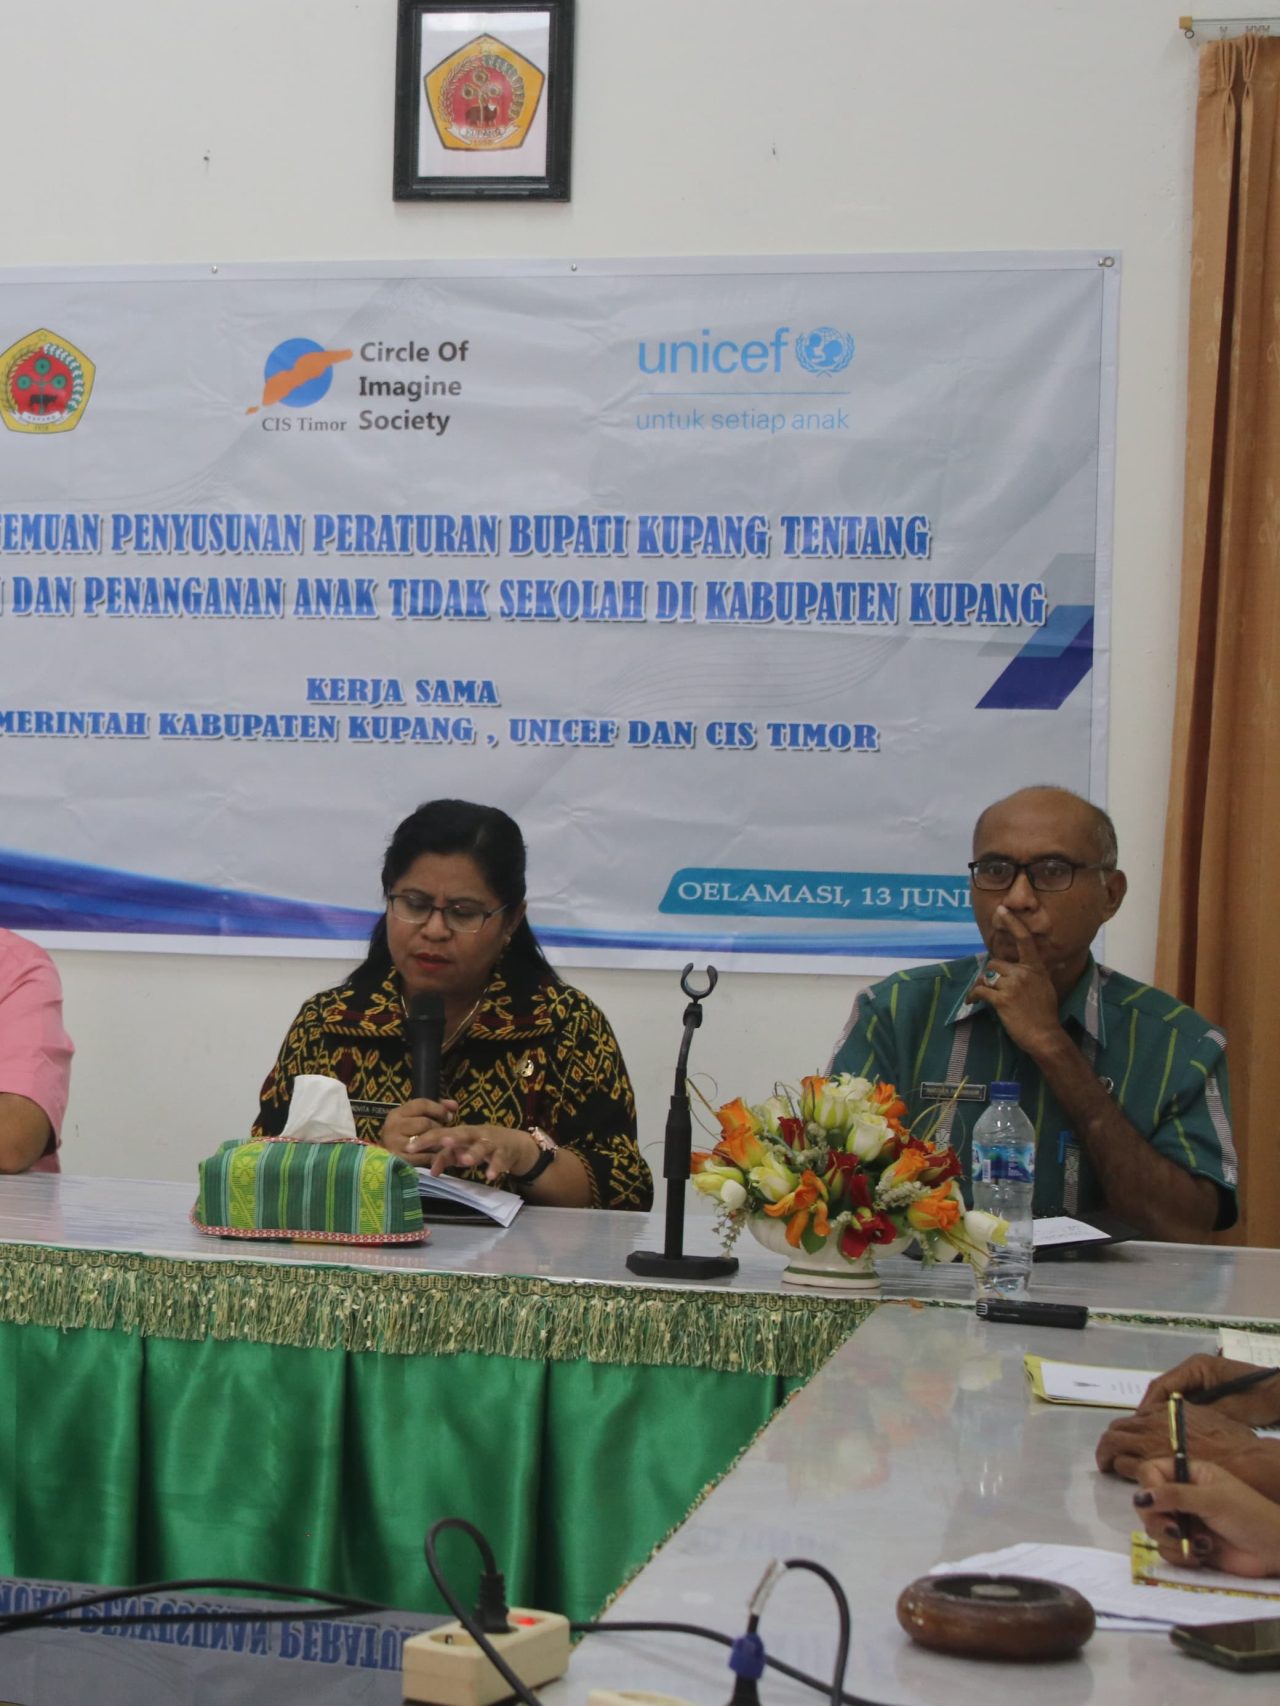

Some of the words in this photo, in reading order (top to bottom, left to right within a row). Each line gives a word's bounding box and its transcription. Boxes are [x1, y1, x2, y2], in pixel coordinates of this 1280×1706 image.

[359, 341, 430, 362] Circle
[438, 340, 470, 362] Of
[637, 326, 790, 375] unicef
[359, 375, 462, 402] Imagine
[261, 417, 293, 432] CIS
[297, 417, 347, 432] Timor
[358, 409, 451, 437] Society
[635, 409, 705, 433] untuk
[710, 408, 788, 434] setiap
[790, 409, 850, 432] anak
[110, 511, 304, 555] PENYUSUNAN
[312, 512, 499, 557] PERATURAN
[509, 513, 628, 557] BUPATI
[637, 514, 770, 558] KUPANG
[779, 514, 931, 559] TENTANG
[11, 575, 75, 617] DAN
[83, 575, 284, 618] PENANGANAN
[293, 576, 379, 619] ANAK
[388, 577, 489, 621] TIDAK
[498, 578, 647, 622] SEKOLAH
[655, 579, 696, 623] DI
[705, 580, 899, 625] KABUPATEN
[909, 582, 1047, 627] KUPANG
[306, 676, 403, 706] KERJA
[414, 678, 499, 707] SAMA
[159, 711, 338, 741] KABUPATEN
[347, 714, 475, 743] KUPANG
[509, 718, 618, 747] UNICEF
[627, 719, 695, 748] DAN
[705, 720, 755, 749] CIS
[767, 721, 880, 751] TIMOR
[677, 881, 851, 909] OELAMASI,
[861, 886, 893, 906] 13
[898, 887, 973, 910] JUNI
